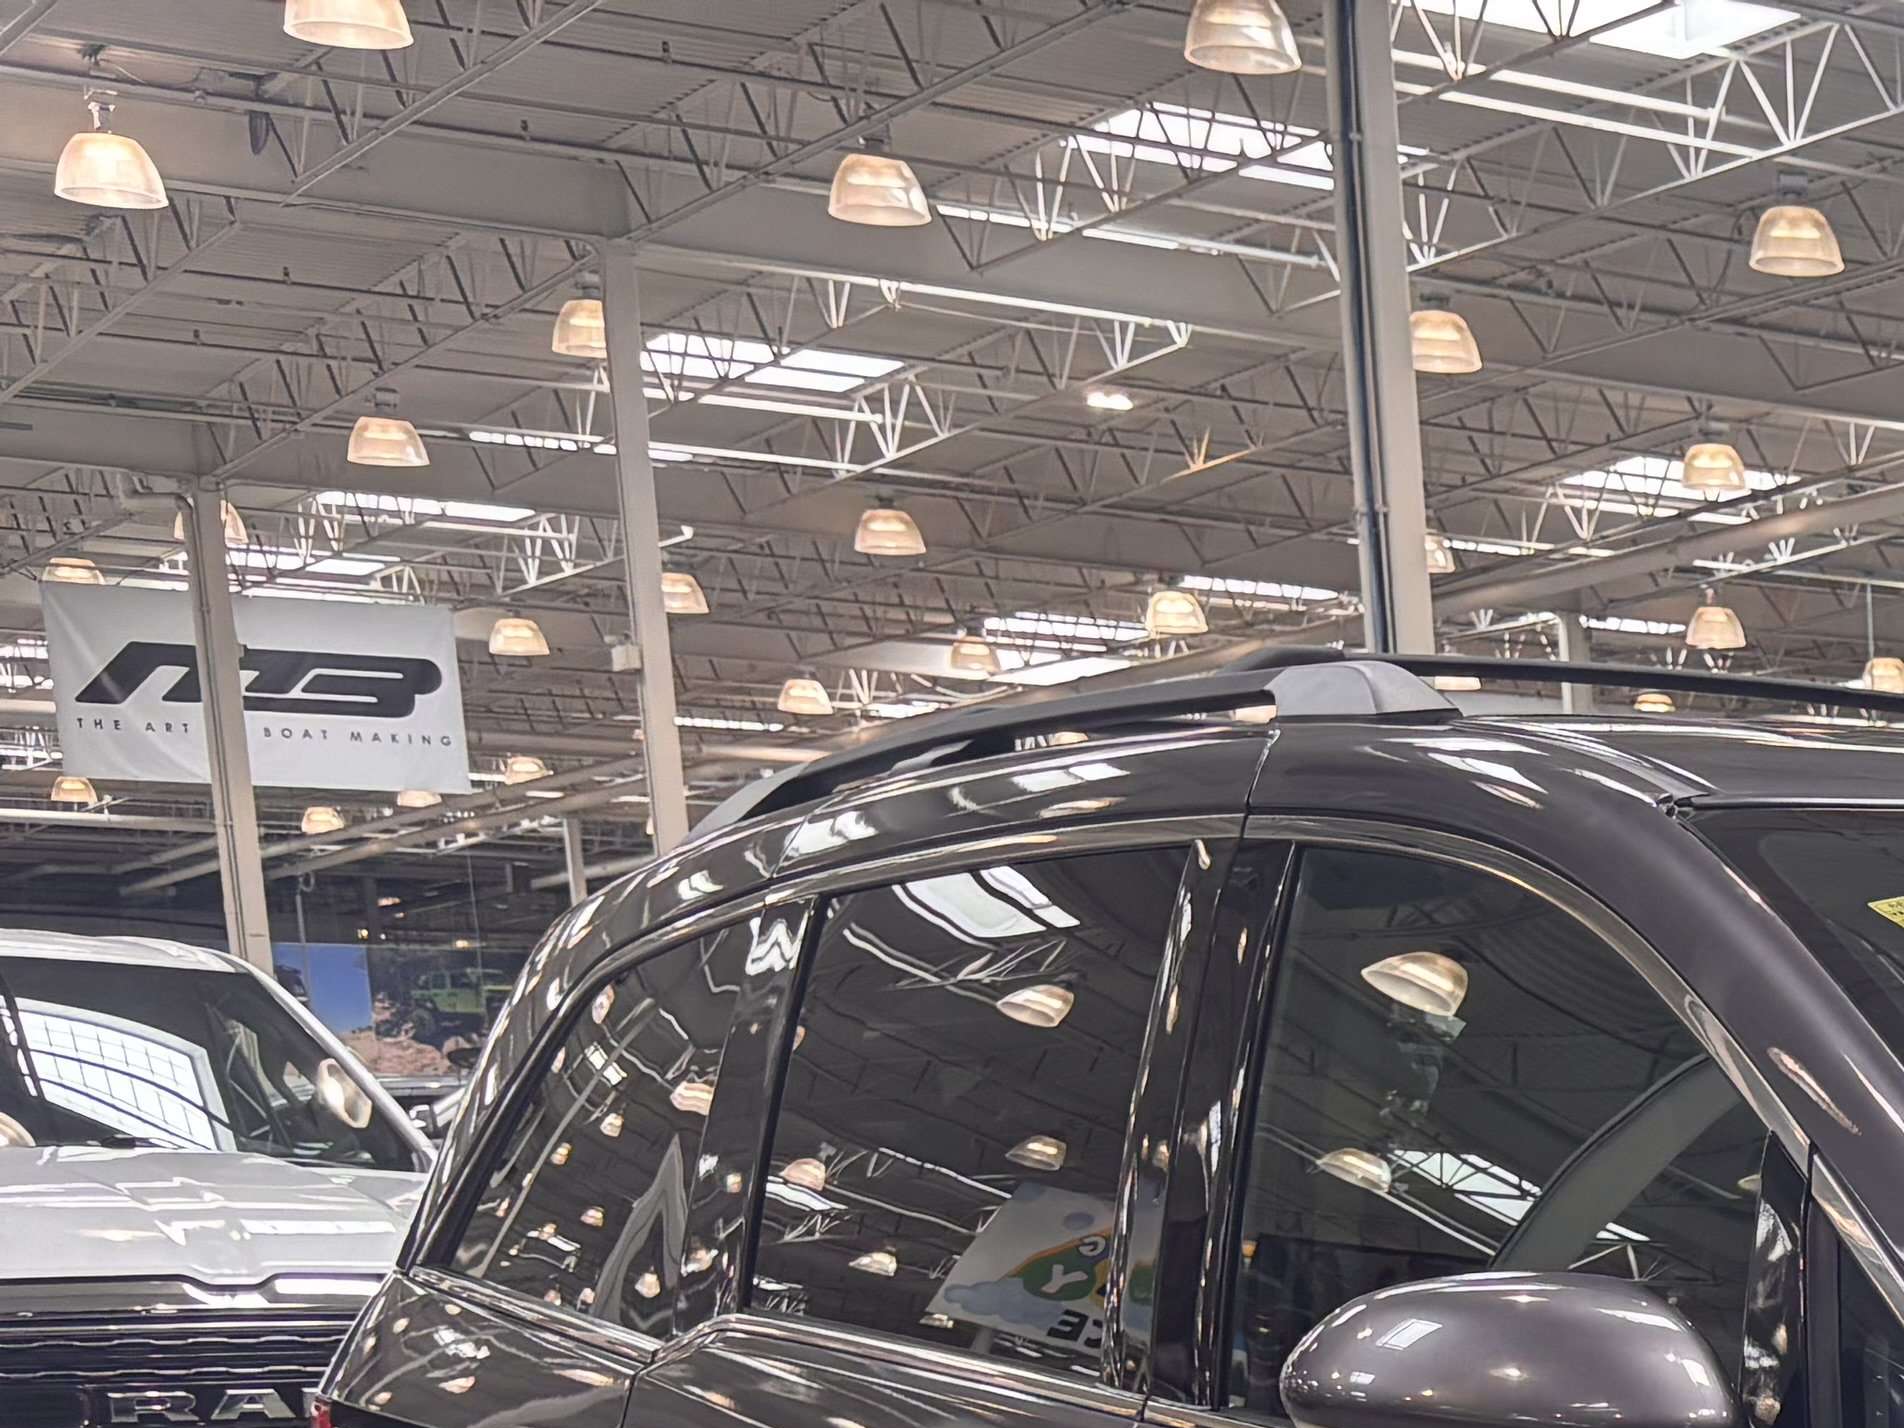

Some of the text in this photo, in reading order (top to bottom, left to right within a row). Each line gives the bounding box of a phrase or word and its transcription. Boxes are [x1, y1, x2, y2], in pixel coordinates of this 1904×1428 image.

[76, 717, 452, 747] THE ART BOAT MAKING
[106, 1388, 316, 1423] RA
